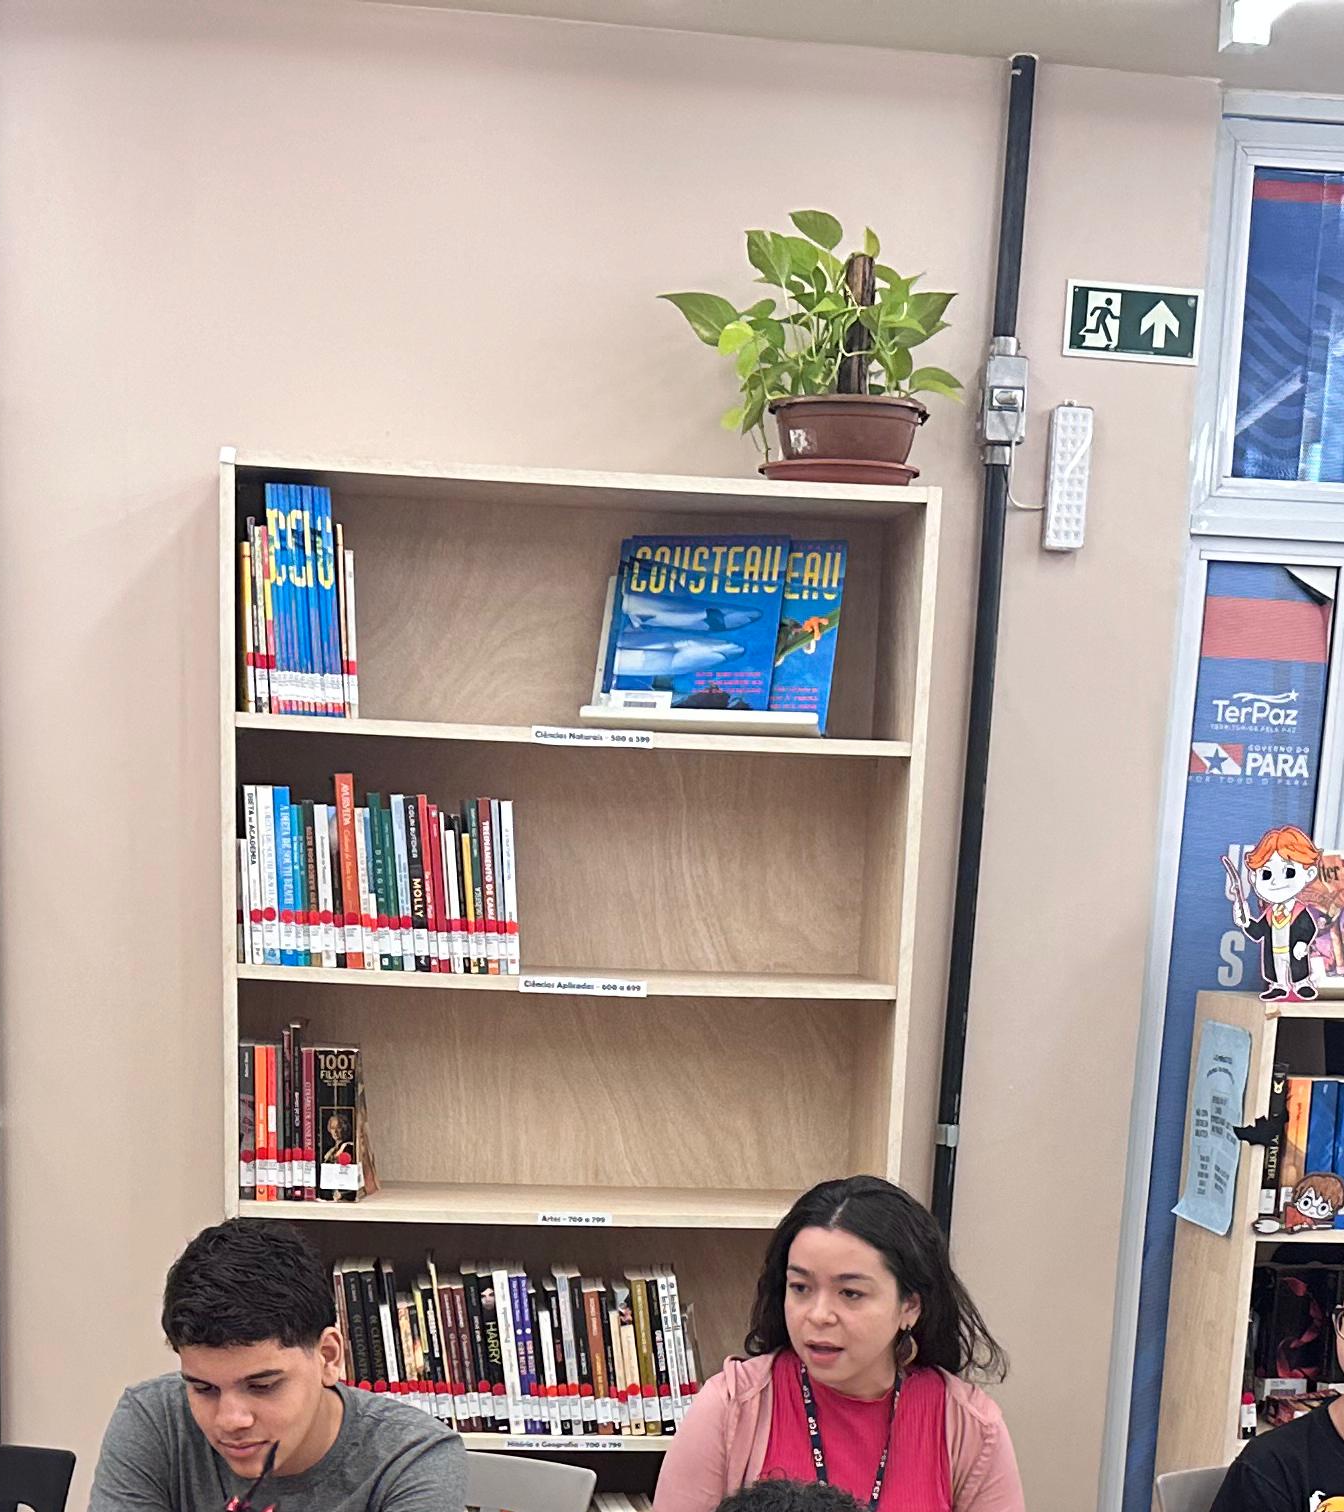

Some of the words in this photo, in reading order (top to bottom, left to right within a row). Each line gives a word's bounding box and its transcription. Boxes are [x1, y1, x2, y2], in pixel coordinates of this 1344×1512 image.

[630, 546, 781, 593] COUSTEAU
[1212, 699, 1298, 726] TerPaz
[1247, 744, 1293, 753] GOVERNO
[1296, 745, 1310, 753] DO
[247, 792, 255, 816] DIETA
[340, 783, 352, 826] AYURVEDA
[408, 804, 416, 828] COLIN
[248, 824, 257, 865] ACADEMIA
[409, 828, 418, 859] BUTCHER
[481, 820, 494, 882] TREINAMENTO
[374, 849, 384, 902] DENGUE
[486, 884, 495, 896] DE
[413, 878, 424, 918] MOLLY
[318, 1054, 355, 1070] 1001
[320, 1069, 354, 1080] FILMES
[1267, 1145, 1280, 1181] POTTER
[485, 1321, 502, 1366] HARRY
